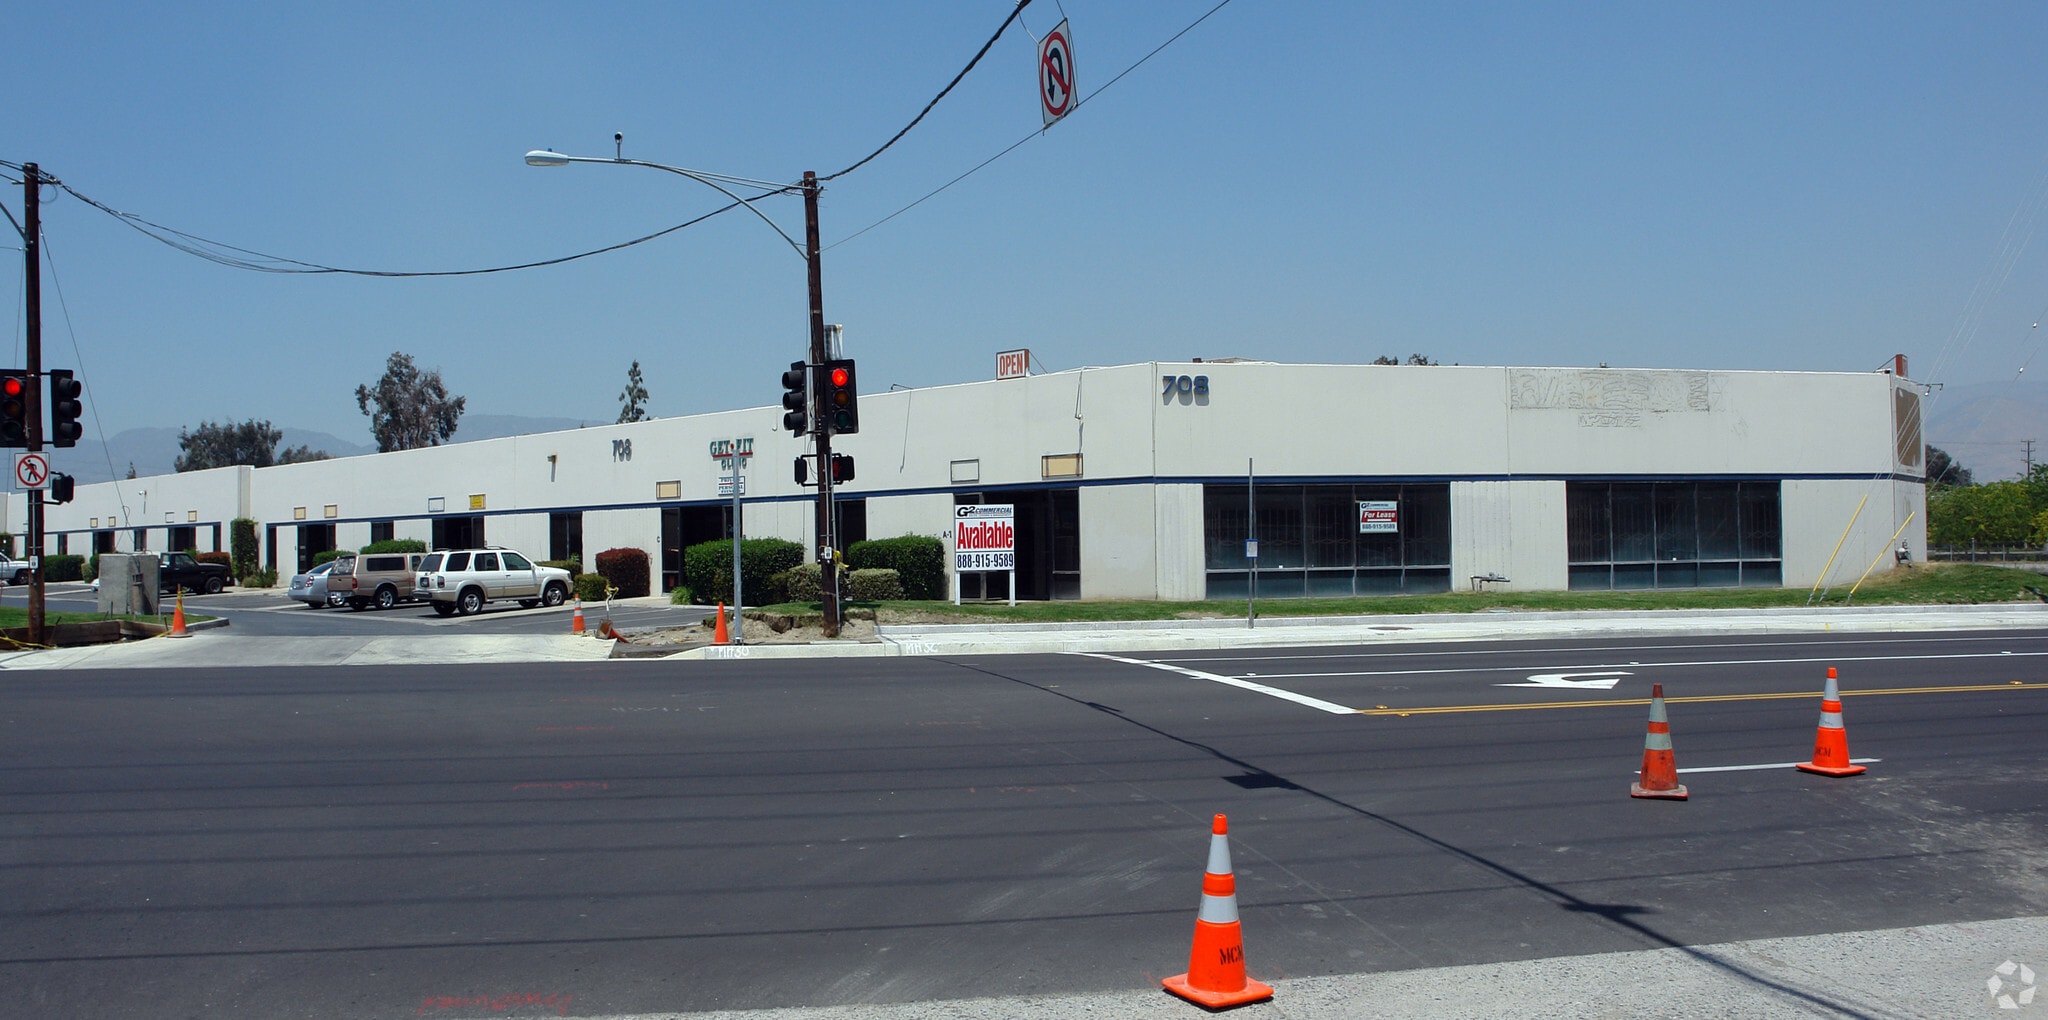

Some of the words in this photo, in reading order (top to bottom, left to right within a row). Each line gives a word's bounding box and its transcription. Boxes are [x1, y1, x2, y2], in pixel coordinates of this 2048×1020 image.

[999, 353, 1023, 376] OPEN
[1162, 375, 1209, 396] 708
[612, 438, 632, 458] 708
[721, 457, 747, 469] CLIIC
[957, 521, 1013, 549] Available
[957, 553, 1014, 568] 888-915-9589
